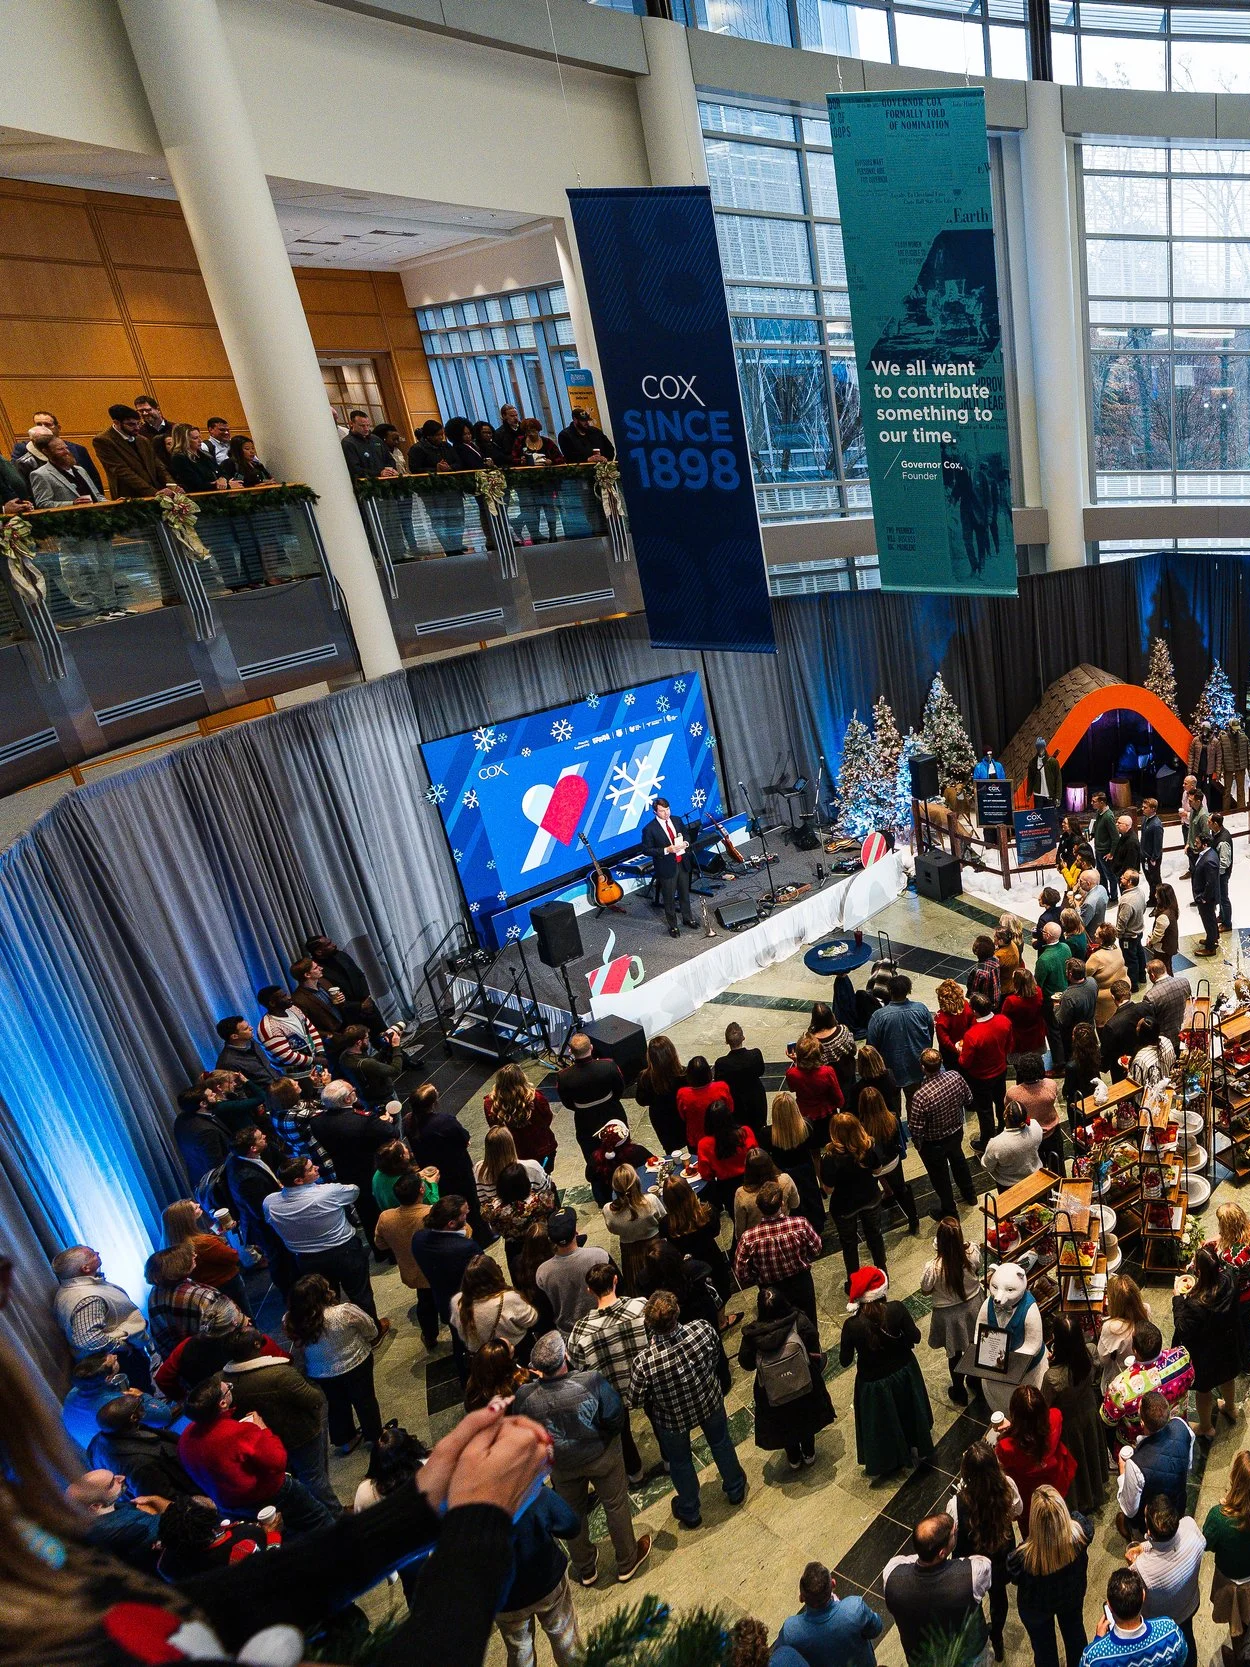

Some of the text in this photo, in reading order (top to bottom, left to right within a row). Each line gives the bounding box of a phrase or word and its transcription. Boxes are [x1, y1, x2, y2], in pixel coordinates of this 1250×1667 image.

[881, 96, 942, 107] GOVERNOR COX
[885, 108, 946, 119] FORMALLY TOLD
[889, 119, 950, 130] OF NOMINATION
[953, 206, 990, 223] Earth
[871, 360, 976, 376] We all want
[641, 374, 706, 407] COX
[873, 382, 990, 399] to contribute
[876, 405, 993, 424] something to
[623, 409, 733, 442] SINCE
[879, 430, 908, 443] our
[912, 427, 957, 443] time.
[629, 447, 741, 490] 1898
[901, 460, 963, 471] Governor Cox,
[902, 472, 937, 480] Founder
[478, 762, 509, 780] COX
[1026, 813, 1043, 821] COX
